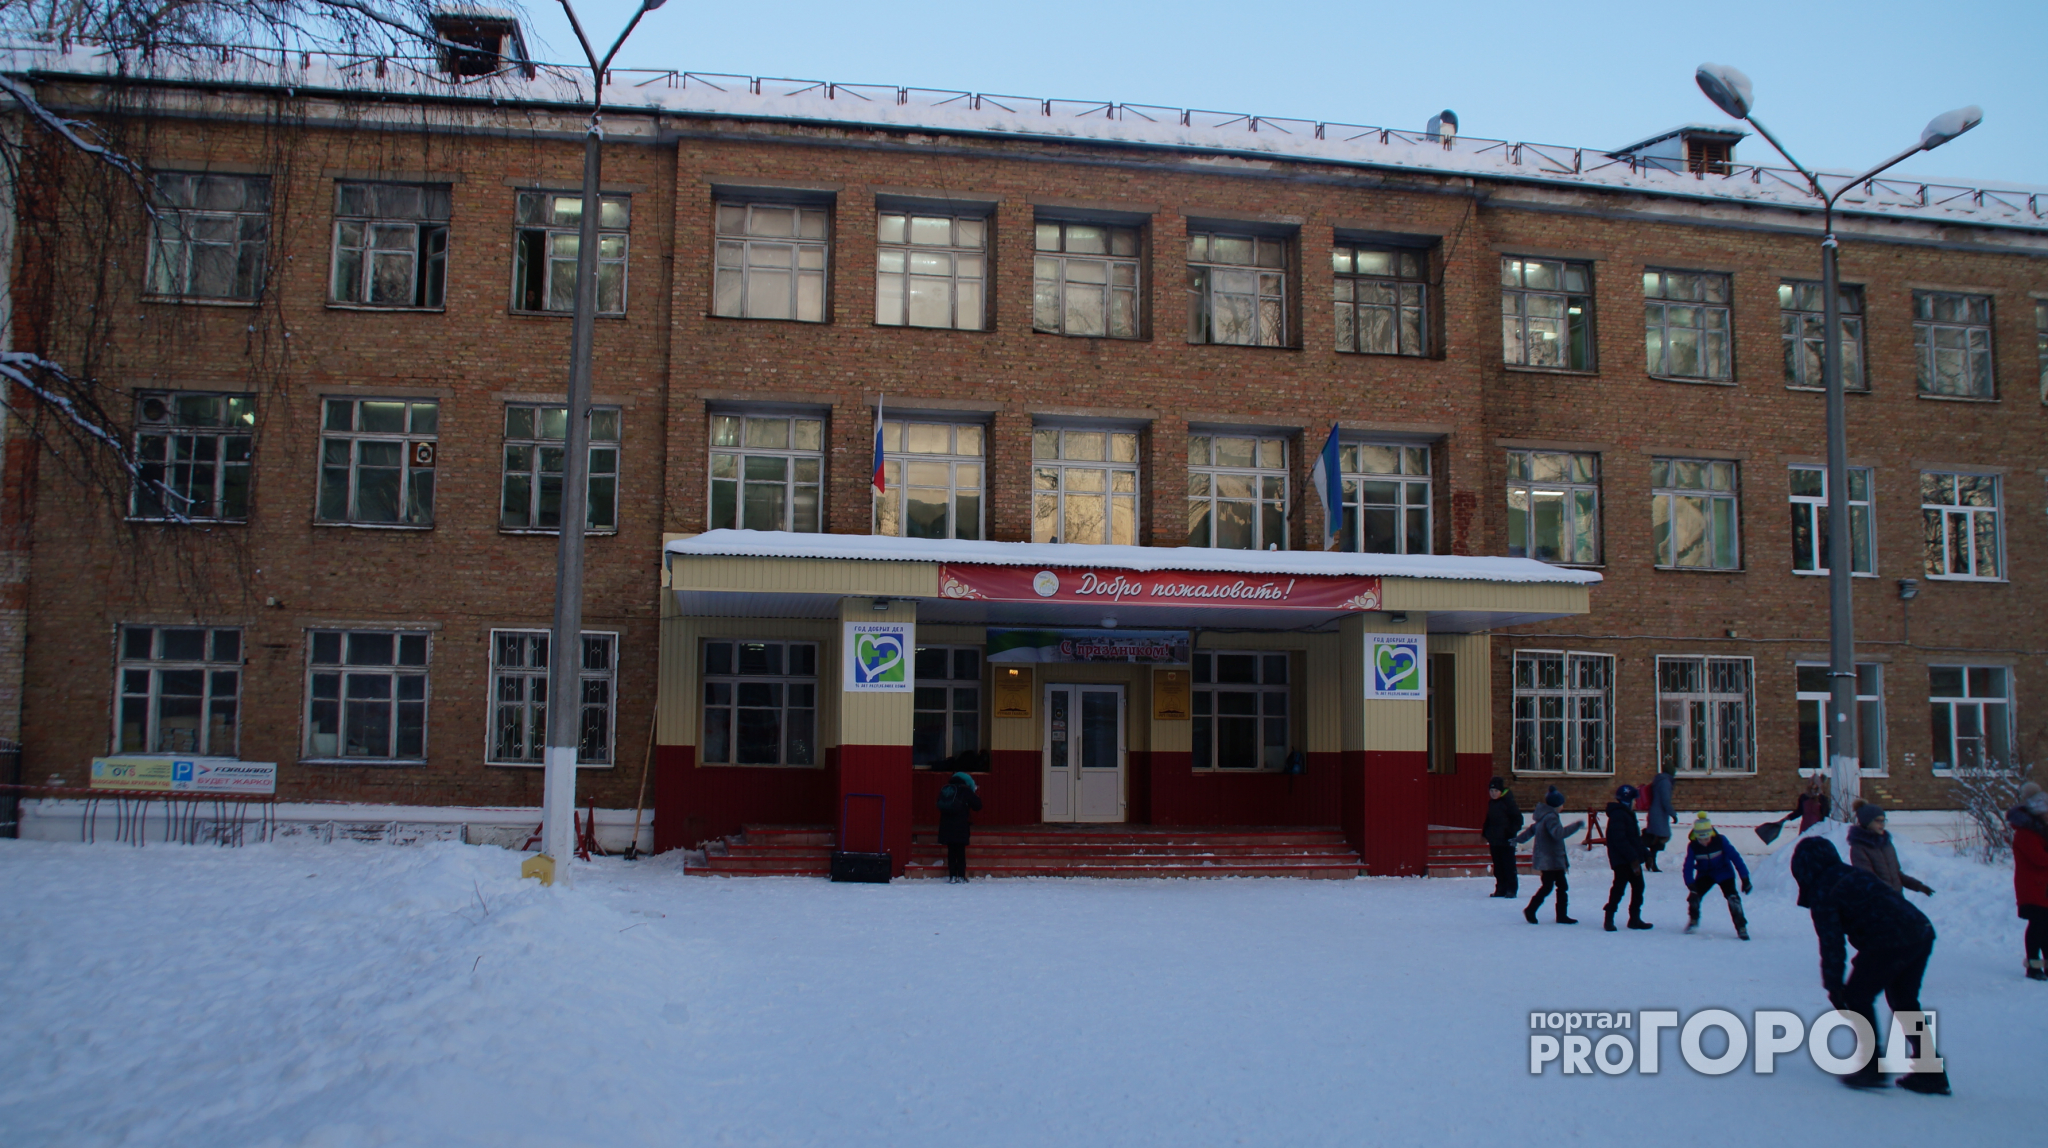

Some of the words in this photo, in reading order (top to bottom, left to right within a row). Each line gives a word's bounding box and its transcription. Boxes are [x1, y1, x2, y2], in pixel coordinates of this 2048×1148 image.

[1075, 572, 1142, 602] Добро
[1150, 578, 1297, 601] пожаловать!
[1060, 641, 1072, 655] С
[1077, 643, 1170, 659] праздником!
[112, 766, 136, 778] OYS
[177, 763, 190, 779] P
[213, 766, 274, 774] FORWARD
[197, 777, 231, 785] БУДЕТ
[232, 778, 273, 786] ЖАРКО!
